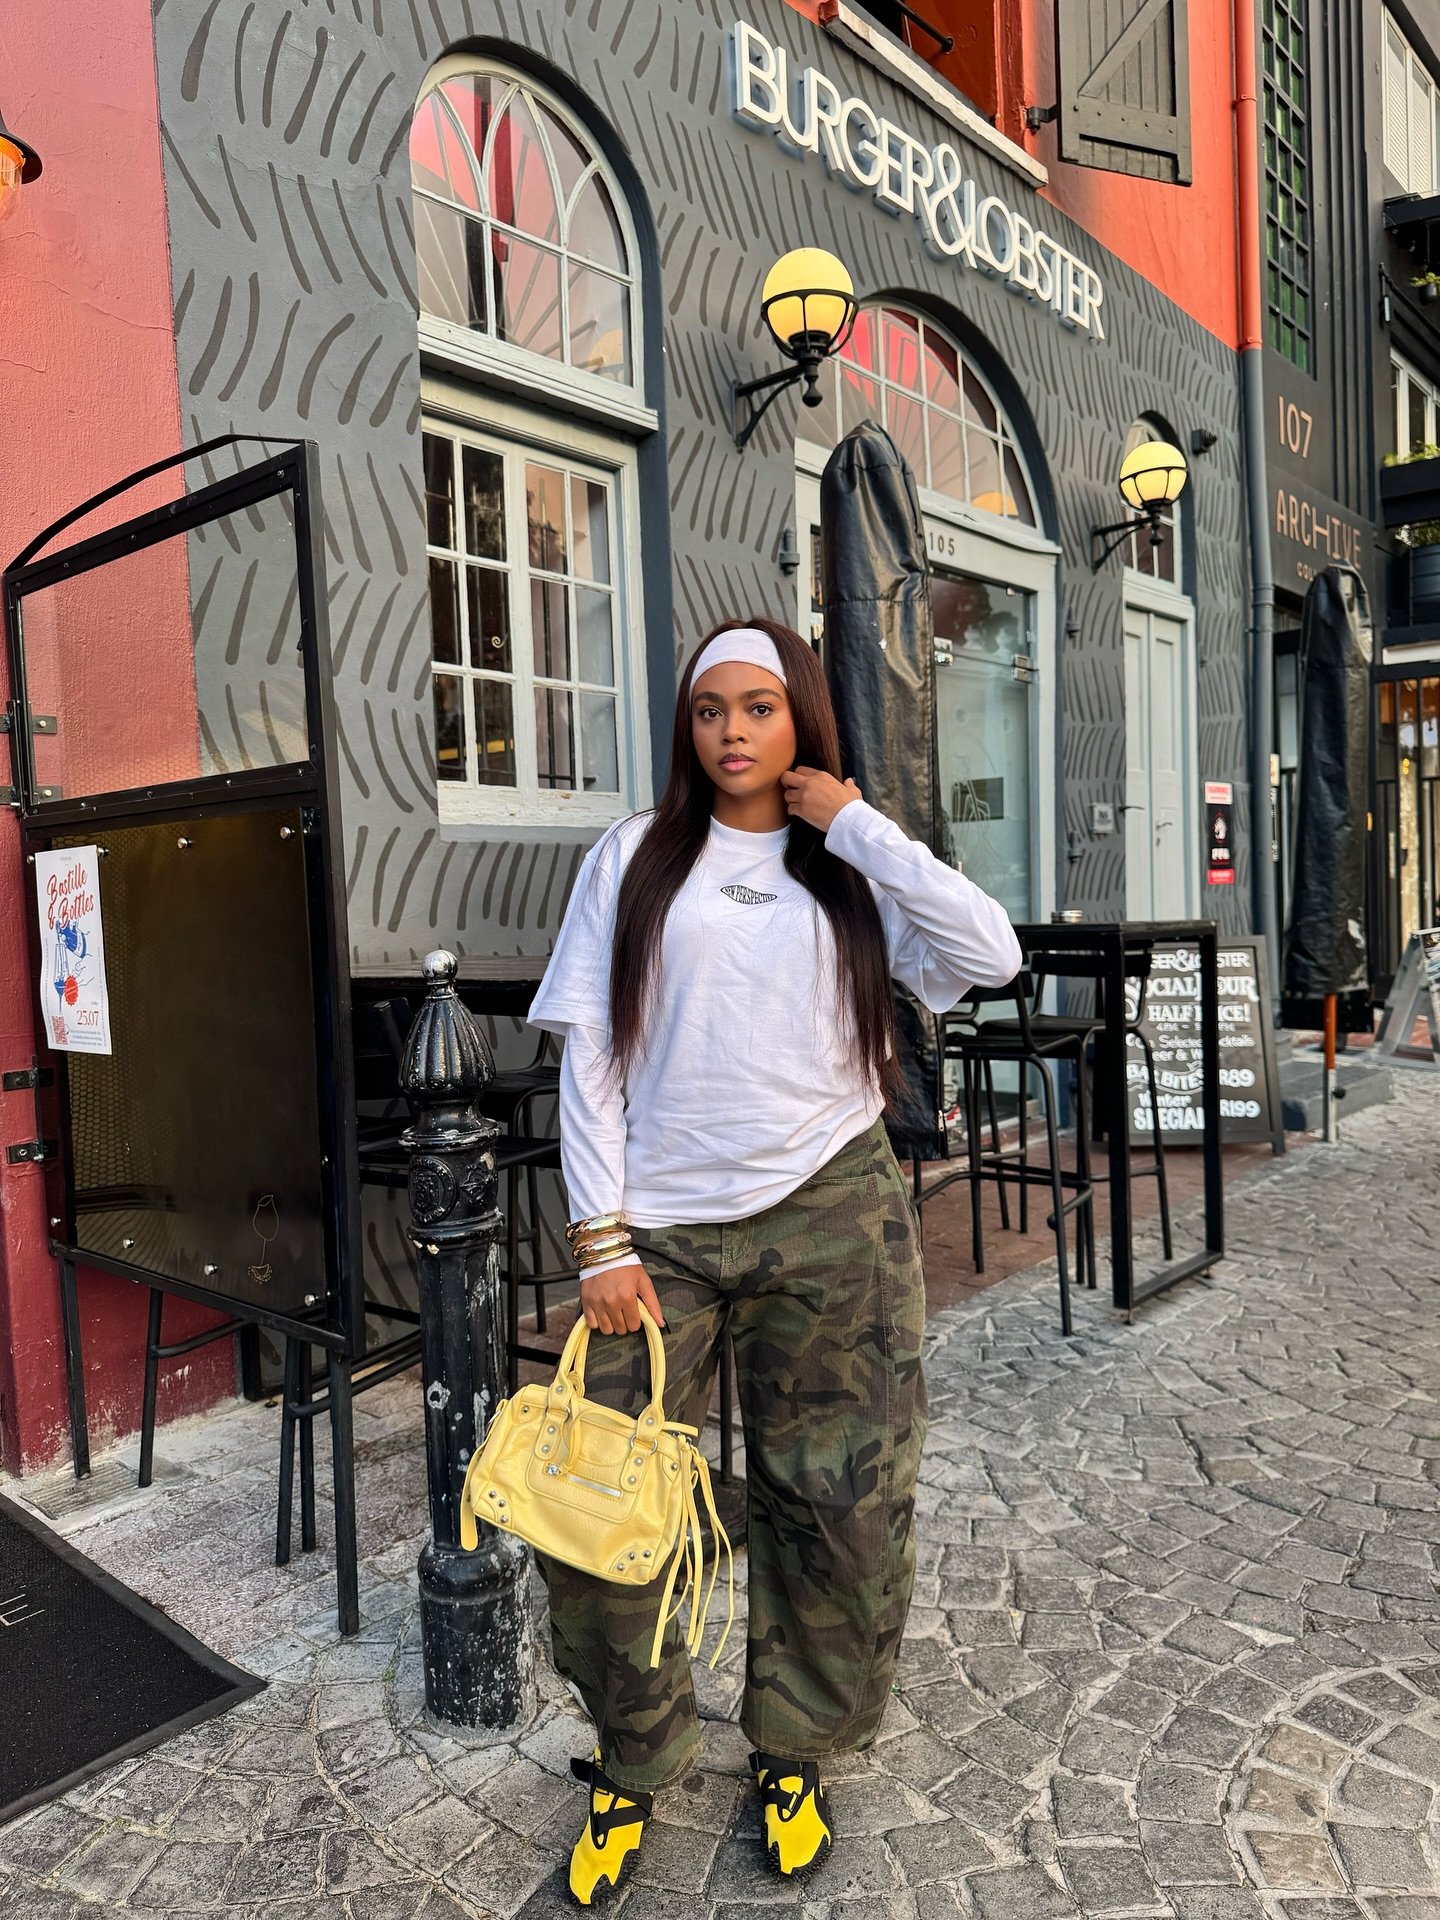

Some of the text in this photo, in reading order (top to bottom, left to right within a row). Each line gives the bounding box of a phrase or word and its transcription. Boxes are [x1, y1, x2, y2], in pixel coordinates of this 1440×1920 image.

[1278, 396, 1313, 459] 107
[1276, 489, 1361, 570] ARCHIVE
[929, 531, 955, 556] 105
[47, 862, 87, 906] Bastille
[58, 890, 94, 929] Bottles
[77, 1010, 99, 1026] 25.07
[1147, 1004, 1193, 1022] HALF
[1152, 1050, 1175, 1062] eer
[1218, 1068, 1256, 1088] R89
[1138, 1090, 1192, 1108] Wnter
